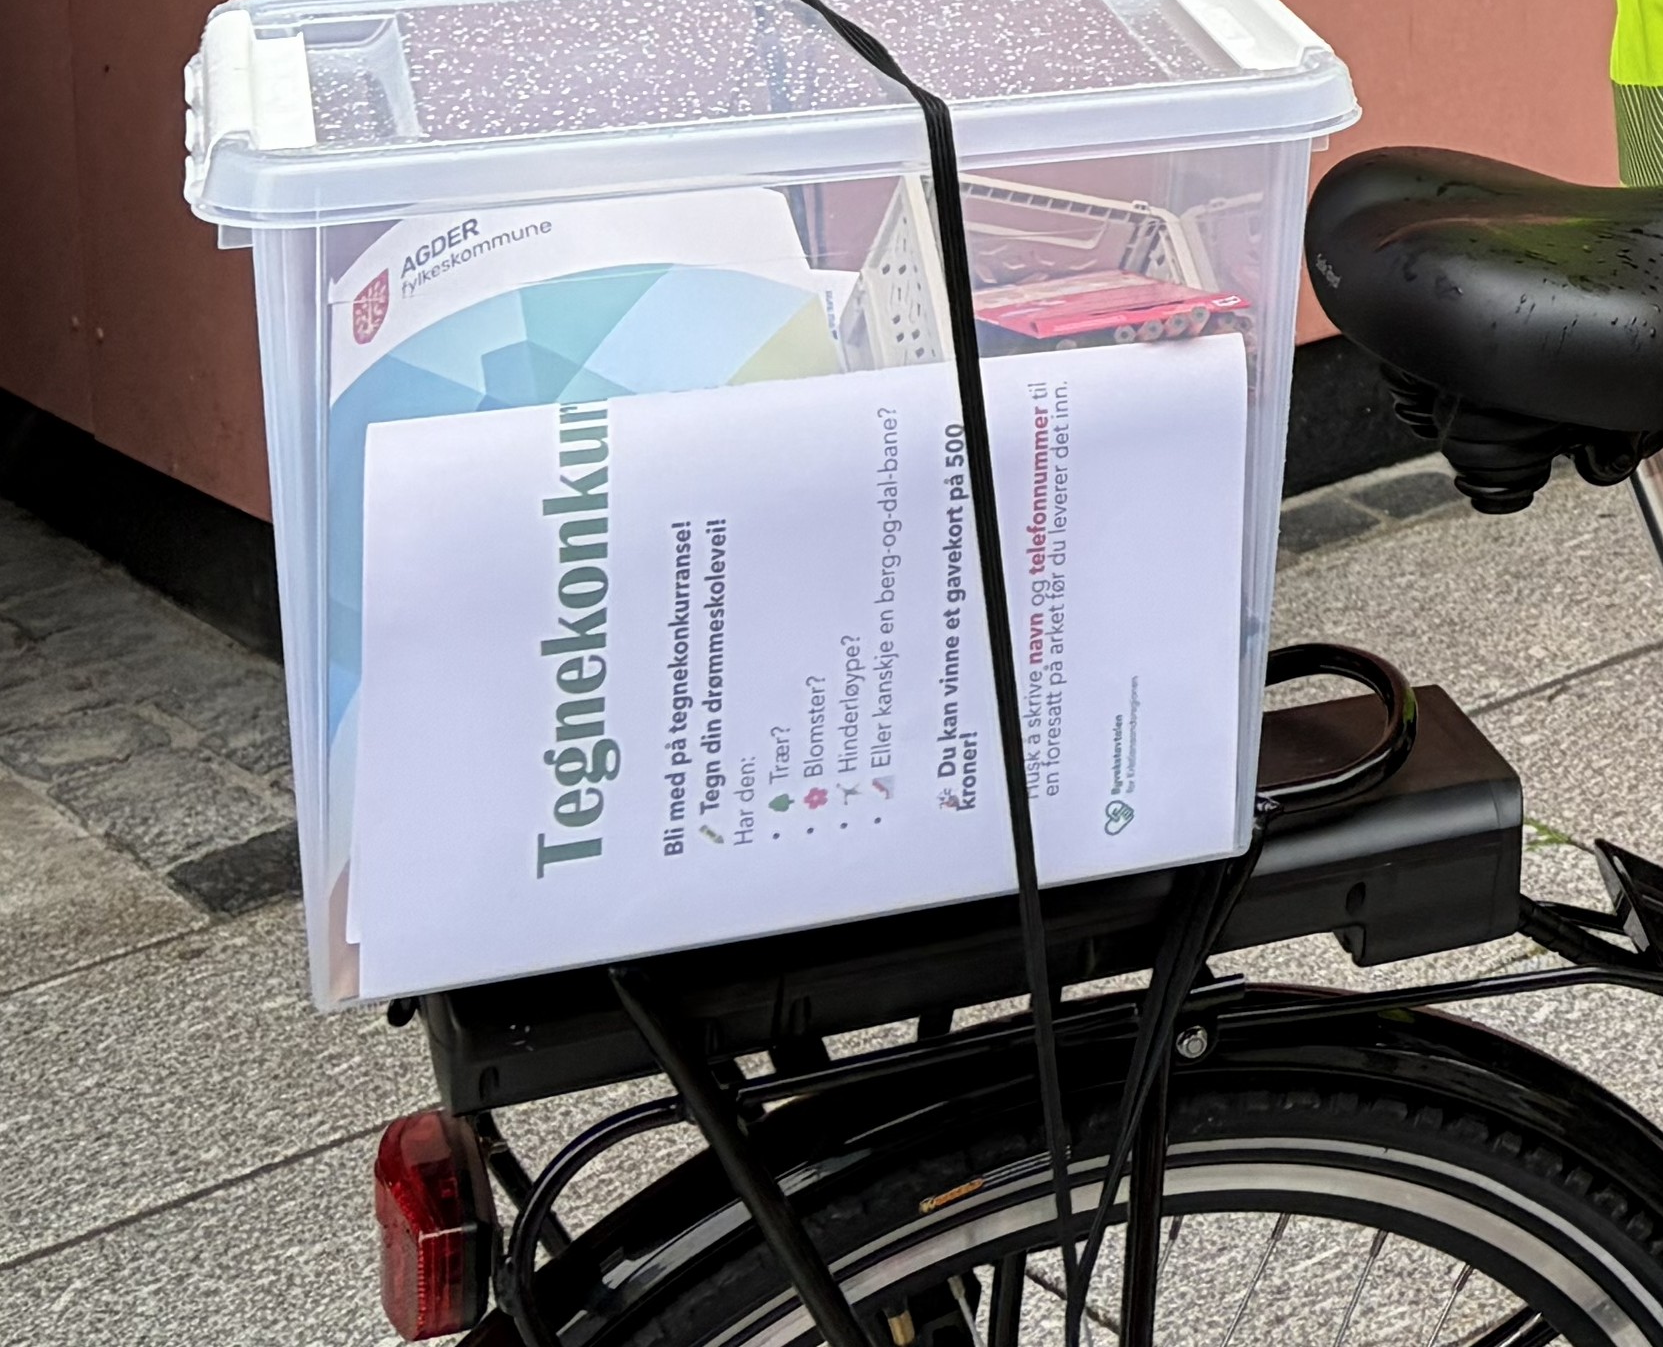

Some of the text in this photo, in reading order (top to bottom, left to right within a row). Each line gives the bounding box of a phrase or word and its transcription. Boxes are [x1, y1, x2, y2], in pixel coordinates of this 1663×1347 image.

[401, 218, 480, 279] AGDER
[401, 221, 552, 295] fylkeskommune
[1027, 381, 1048, 400] til
[1026, 405, 1049, 575] telefonnummer
[870, 407, 902, 768] Eller kanskje en berg-og-dal-bane?
[937, 424, 969, 777] Du kan vinne et gavekort på 500
[1031, 580, 1050, 607] og
[1041, 380, 1070, 796] en foresatt på arket før du leverer det inn.
[700, 518, 728, 815] Tegn din drømmeskolevei!
[1029, 612, 1044, 665] navn
[664, 520, 694, 856] Bli med på tegnekonkurranse!
[804, 676, 826, 778] Blomster?
[838, 634, 865, 775] Hinderløype?
[1023, 671, 1043, 727] skrive
[770, 725, 791, 785] Trær?
[957, 731, 978, 811] kroner!
[734, 757, 757, 846] Har den:
